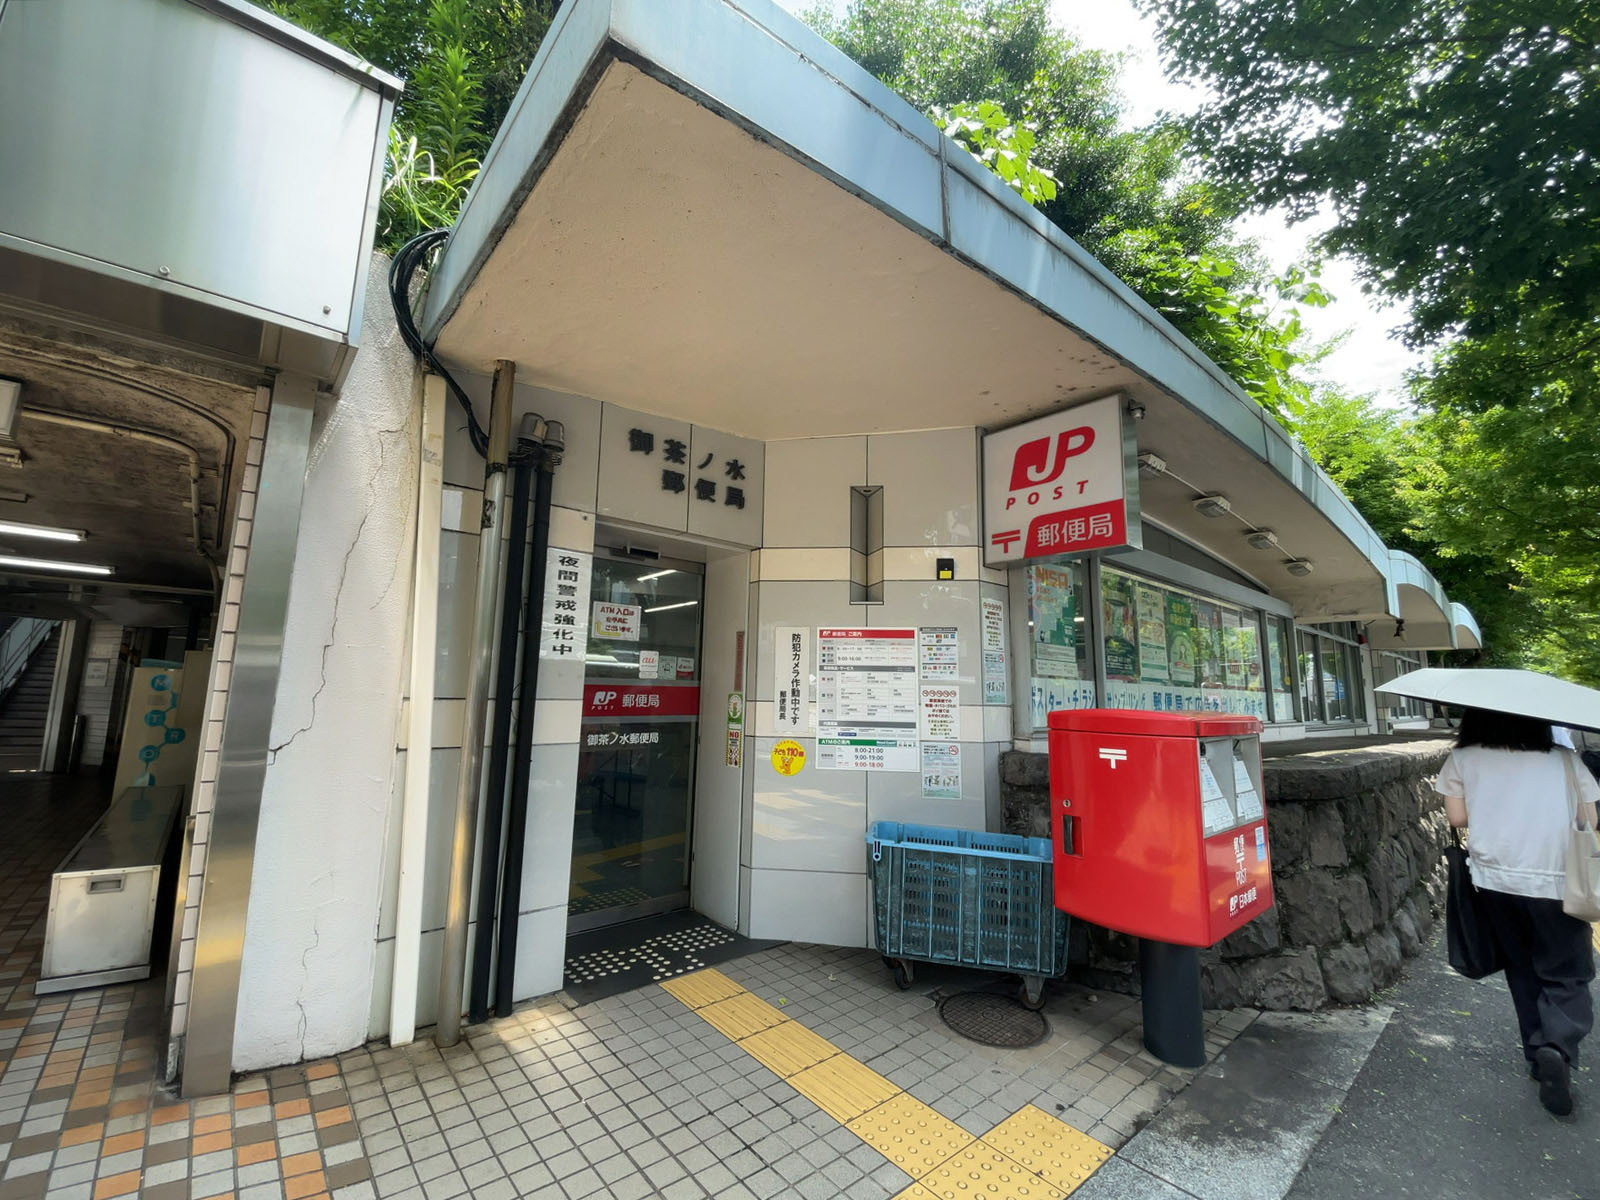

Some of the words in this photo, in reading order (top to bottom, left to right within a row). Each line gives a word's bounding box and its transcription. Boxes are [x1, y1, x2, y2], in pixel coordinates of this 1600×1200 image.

[628, 428, 746, 481] 御茶ノ水
[1009, 425, 1096, 492] JP
[661, 469, 746, 510] 郵便局
[1005, 480, 1089, 511] POST
[1037, 513, 1114, 548] 郵便局
[552, 555, 580, 656] 夜間警戒強化中
[790, 633, 802, 725] 防犯カメラ作動中です
[621, 694, 660, 708] 郵便局
[587, 732, 659, 746] 御茶ノ水郵便局
